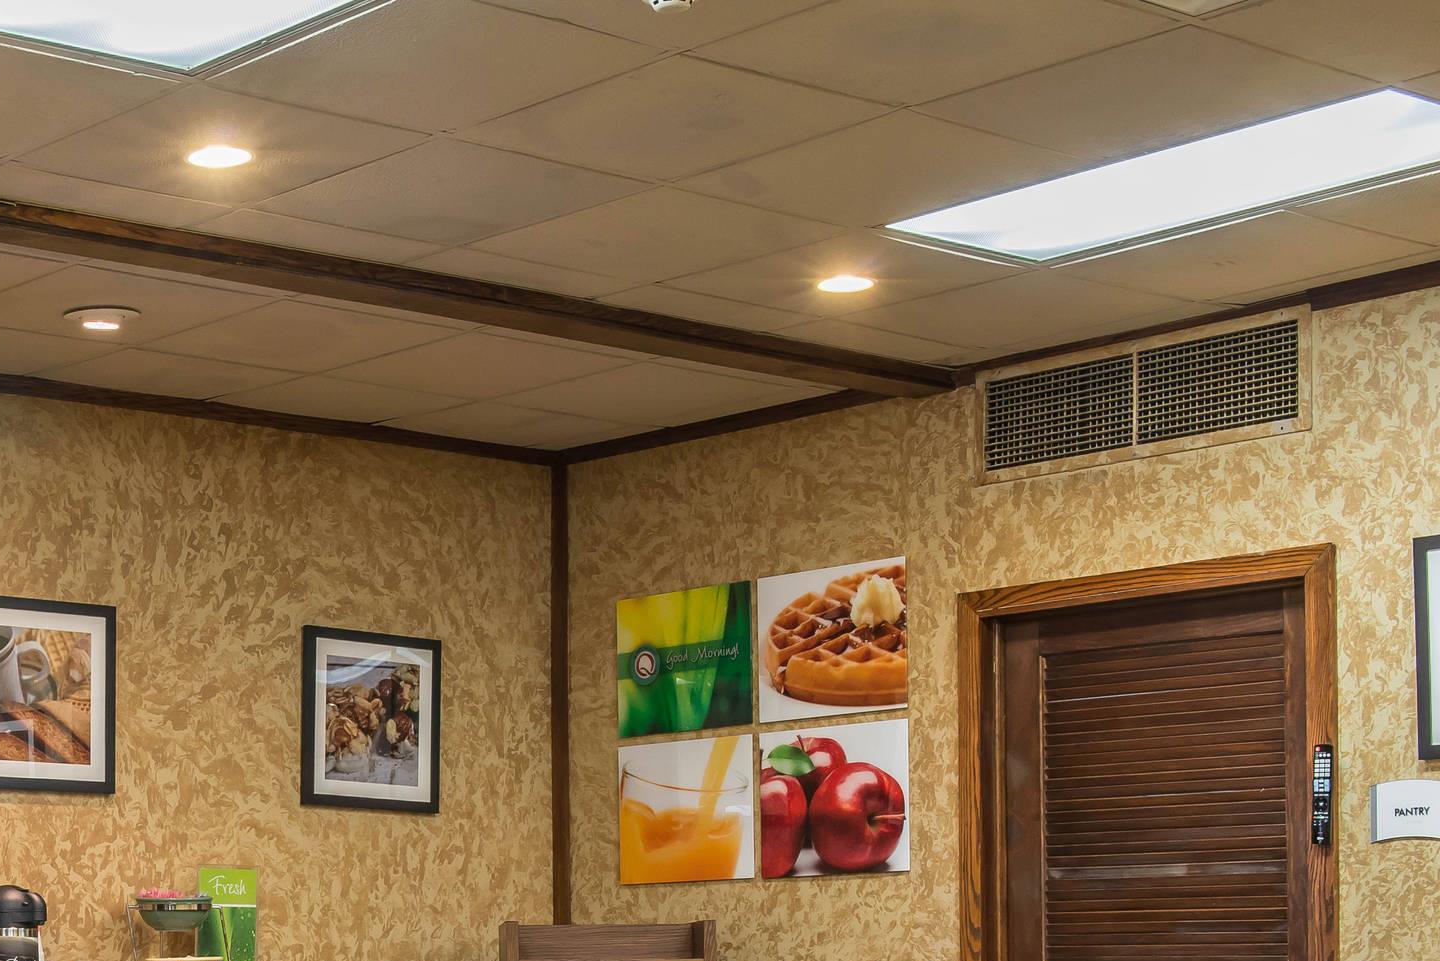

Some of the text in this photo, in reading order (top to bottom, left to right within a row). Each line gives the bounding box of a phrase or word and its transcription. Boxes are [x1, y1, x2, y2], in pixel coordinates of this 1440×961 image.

[666, 642, 740, 670] Good Morning!
[1394, 806, 1431, 817] PANTRY
[208, 875, 247, 896] Fresh
